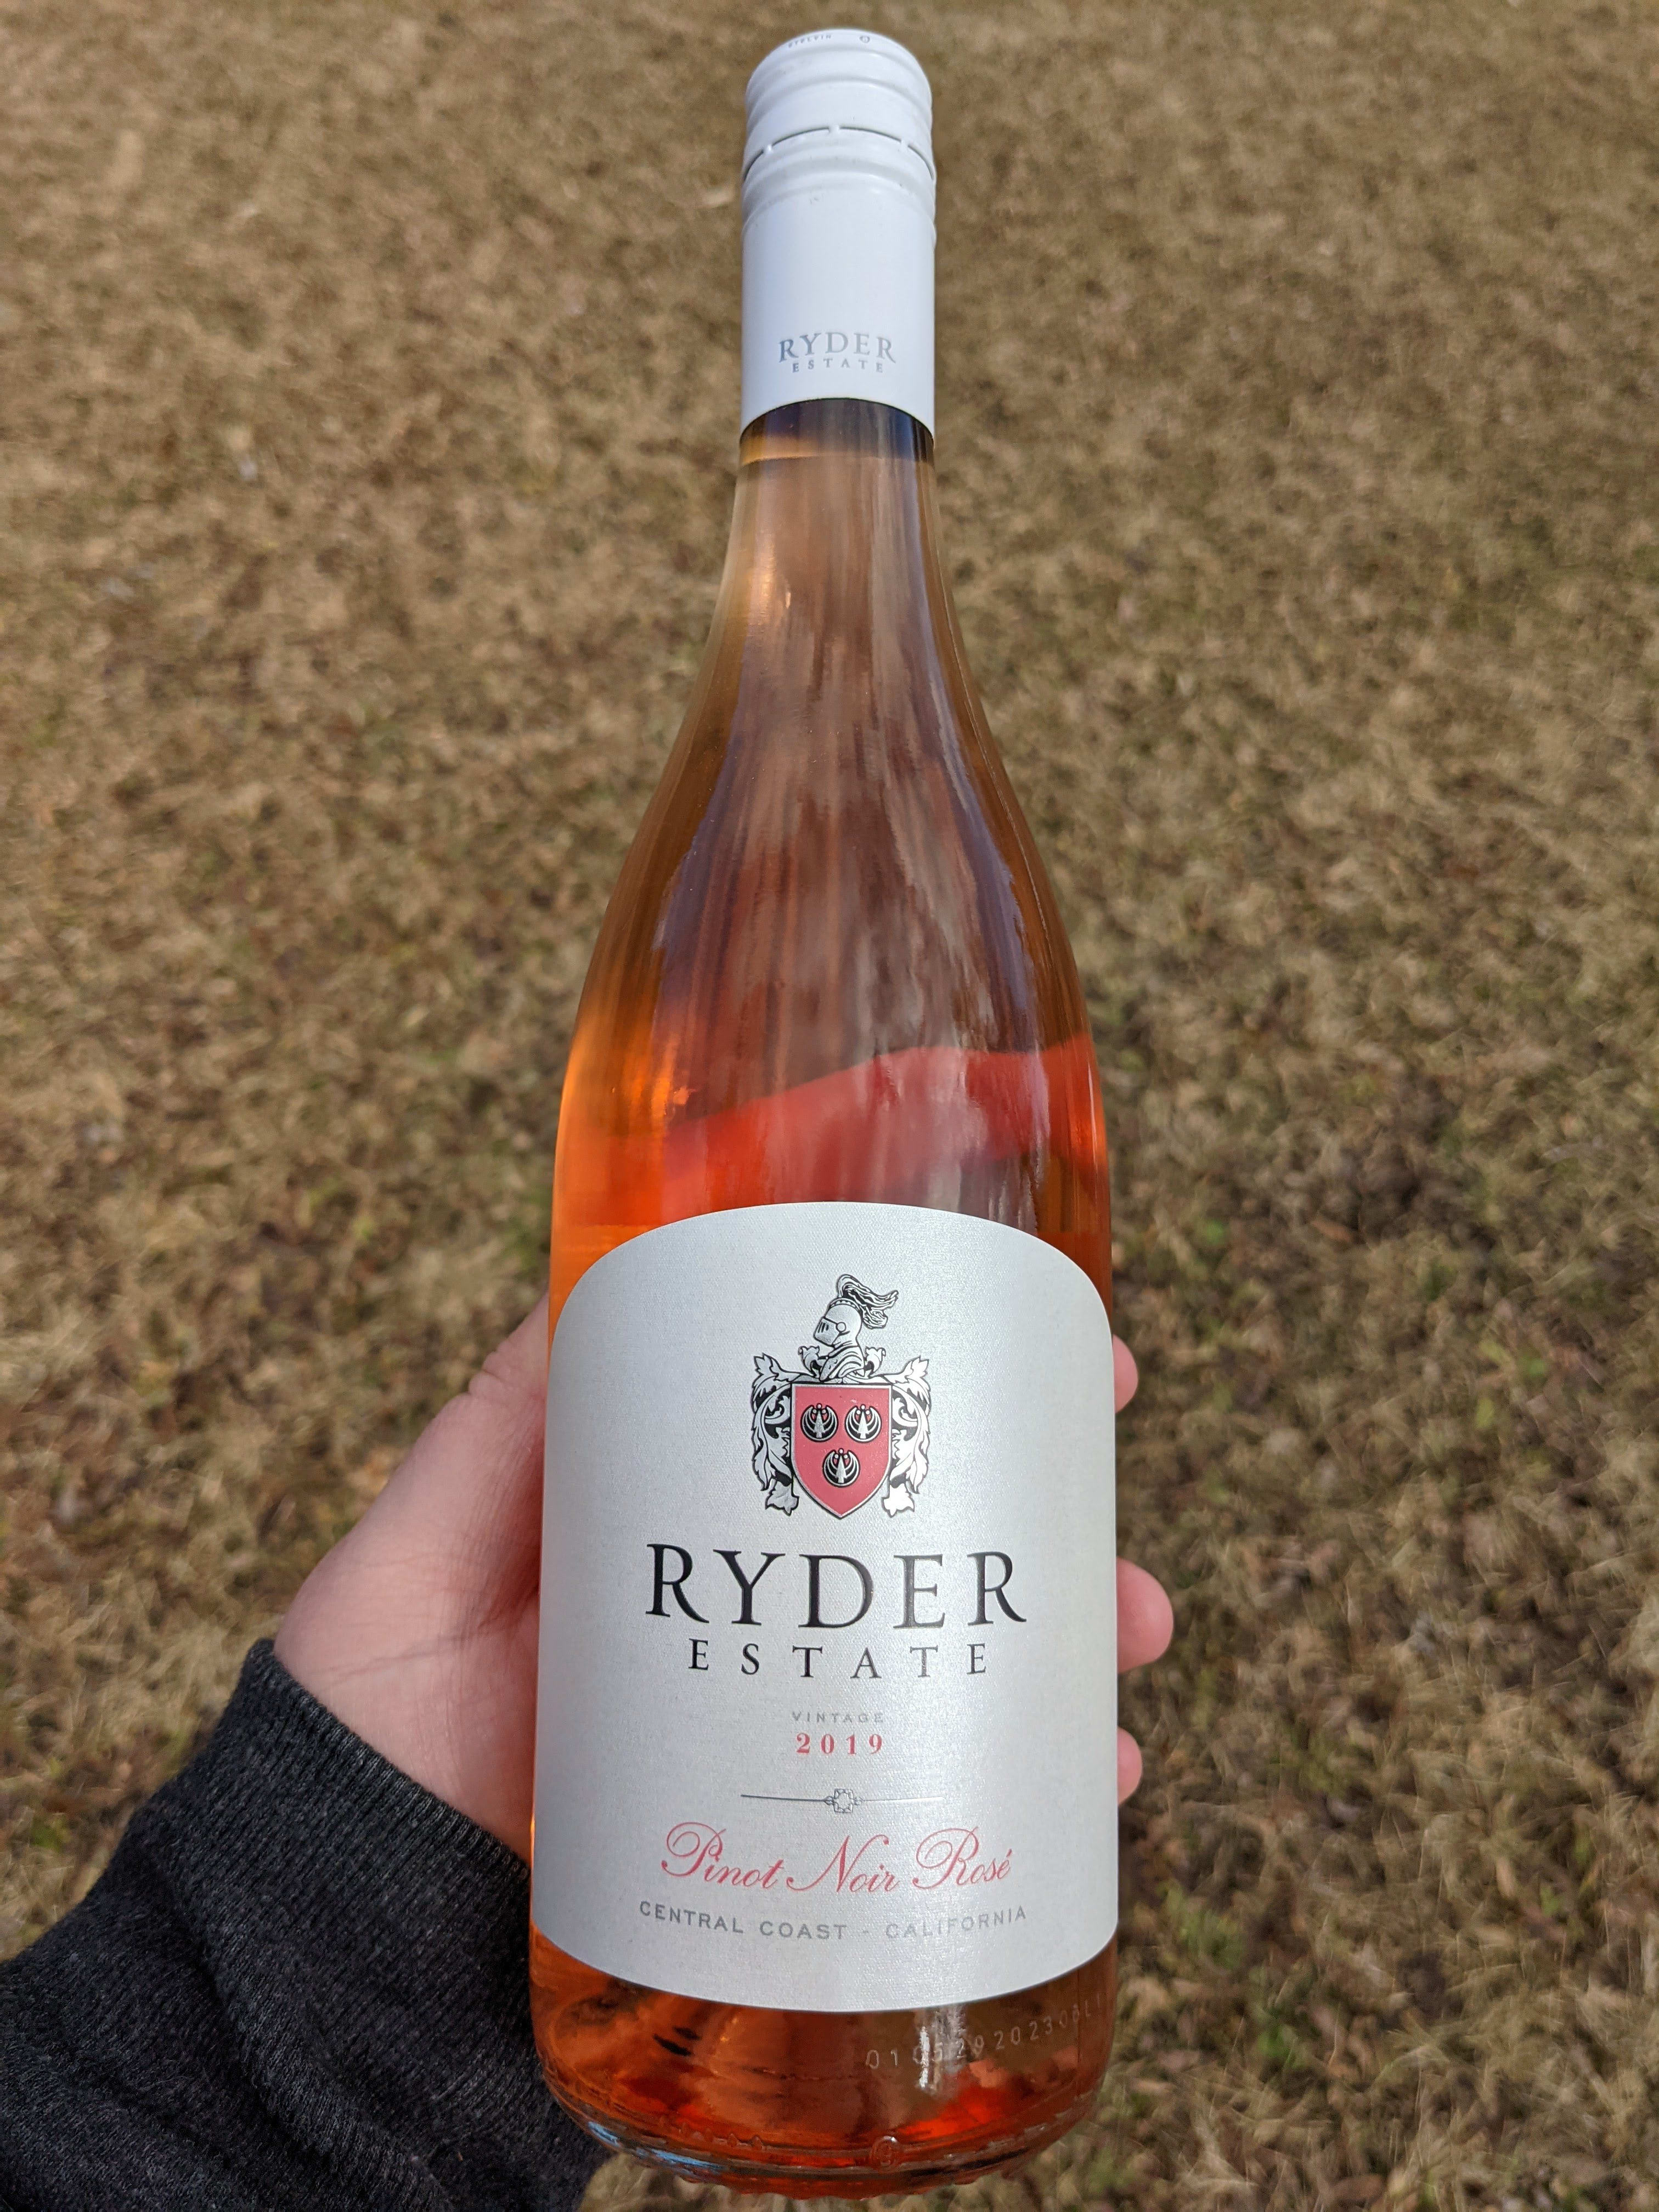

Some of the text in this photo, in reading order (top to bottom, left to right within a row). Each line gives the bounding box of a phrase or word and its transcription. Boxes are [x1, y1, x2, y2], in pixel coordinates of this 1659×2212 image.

[778, 331, 896, 364] RYDER
[792, 358, 883, 373] ESTATE
[645, 1543, 1027, 1629] RYDER
[688, 1638, 987, 1679] ESTATE
[792, 1712, 885, 1724] VINTAGE
[796, 1733, 883, 1754] 2019
[661, 1821, 1012, 1893] Pinot Noir Rosé
[639, 1901, 744, 1934] CENTRAL
[759, 1921, 847, 1940] COAST
[886, 1905, 1026, 1939] CALIFORNIA
